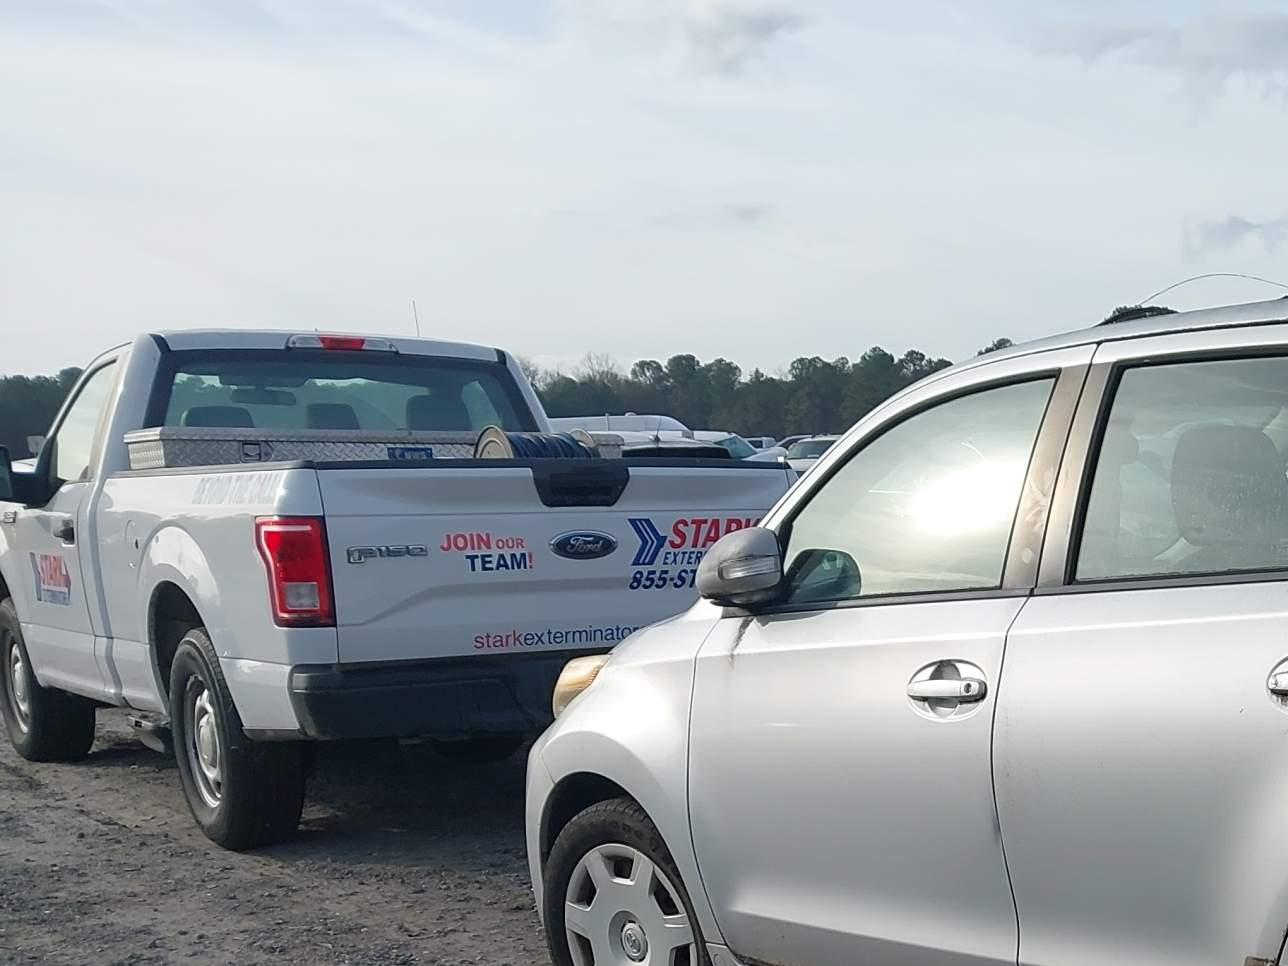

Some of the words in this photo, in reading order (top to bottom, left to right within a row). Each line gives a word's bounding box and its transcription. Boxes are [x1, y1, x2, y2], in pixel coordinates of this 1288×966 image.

[440, 533, 491, 551] JOIN
[496, 538, 524, 549] OUR
[668, 518, 763, 549] STA
[567, 536, 603, 552] Ford
[465, 552, 533, 571] TEAM!
